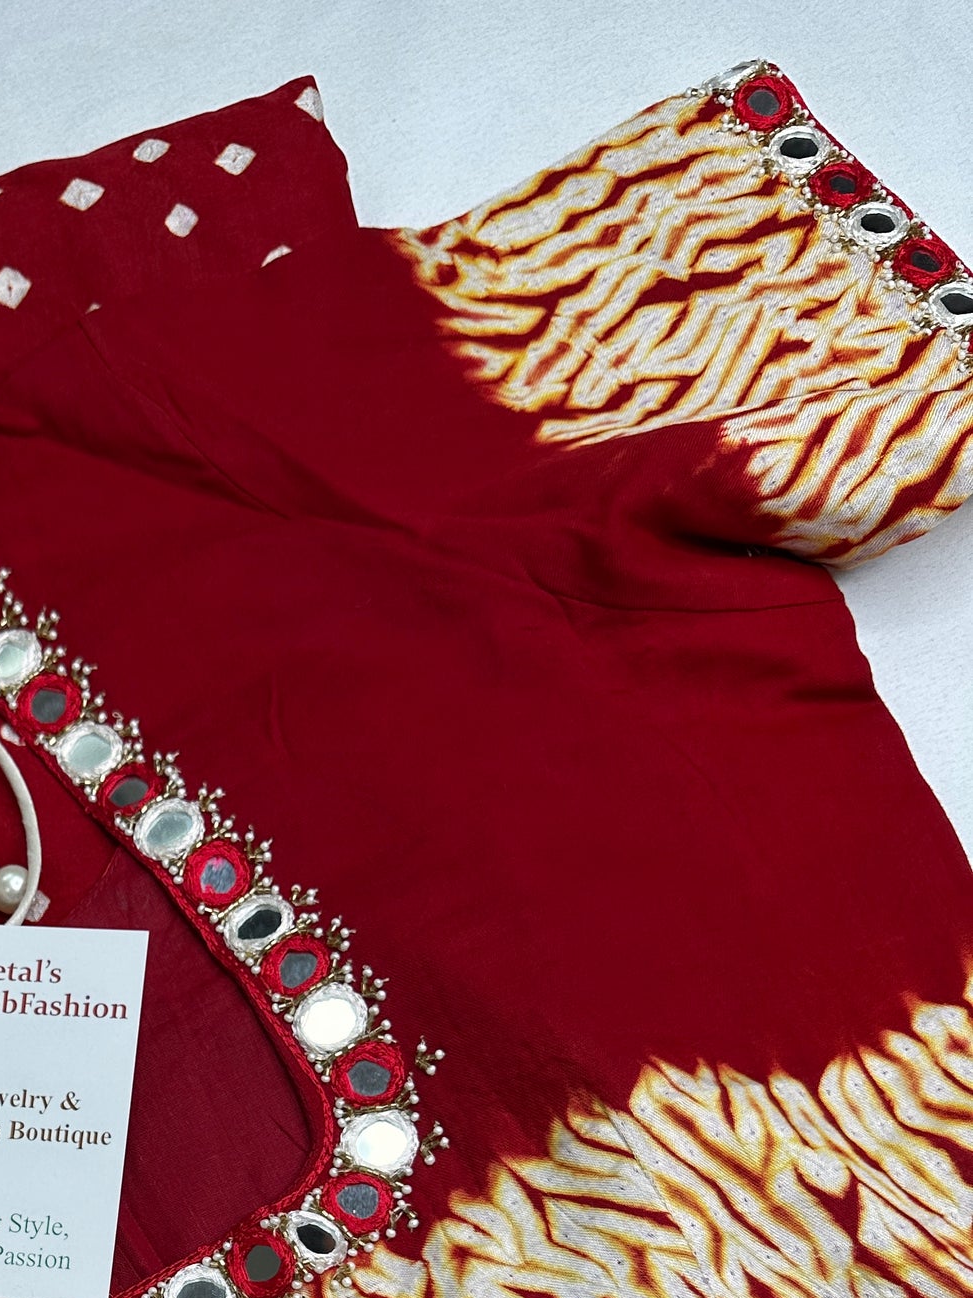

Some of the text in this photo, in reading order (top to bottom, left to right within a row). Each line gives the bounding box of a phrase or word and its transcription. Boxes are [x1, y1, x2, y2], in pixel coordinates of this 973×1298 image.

[60, 1091, 81, 1112] &
[9, 1120, 113, 1150] Boutique
[8, 1212, 70, 1240] Style,
